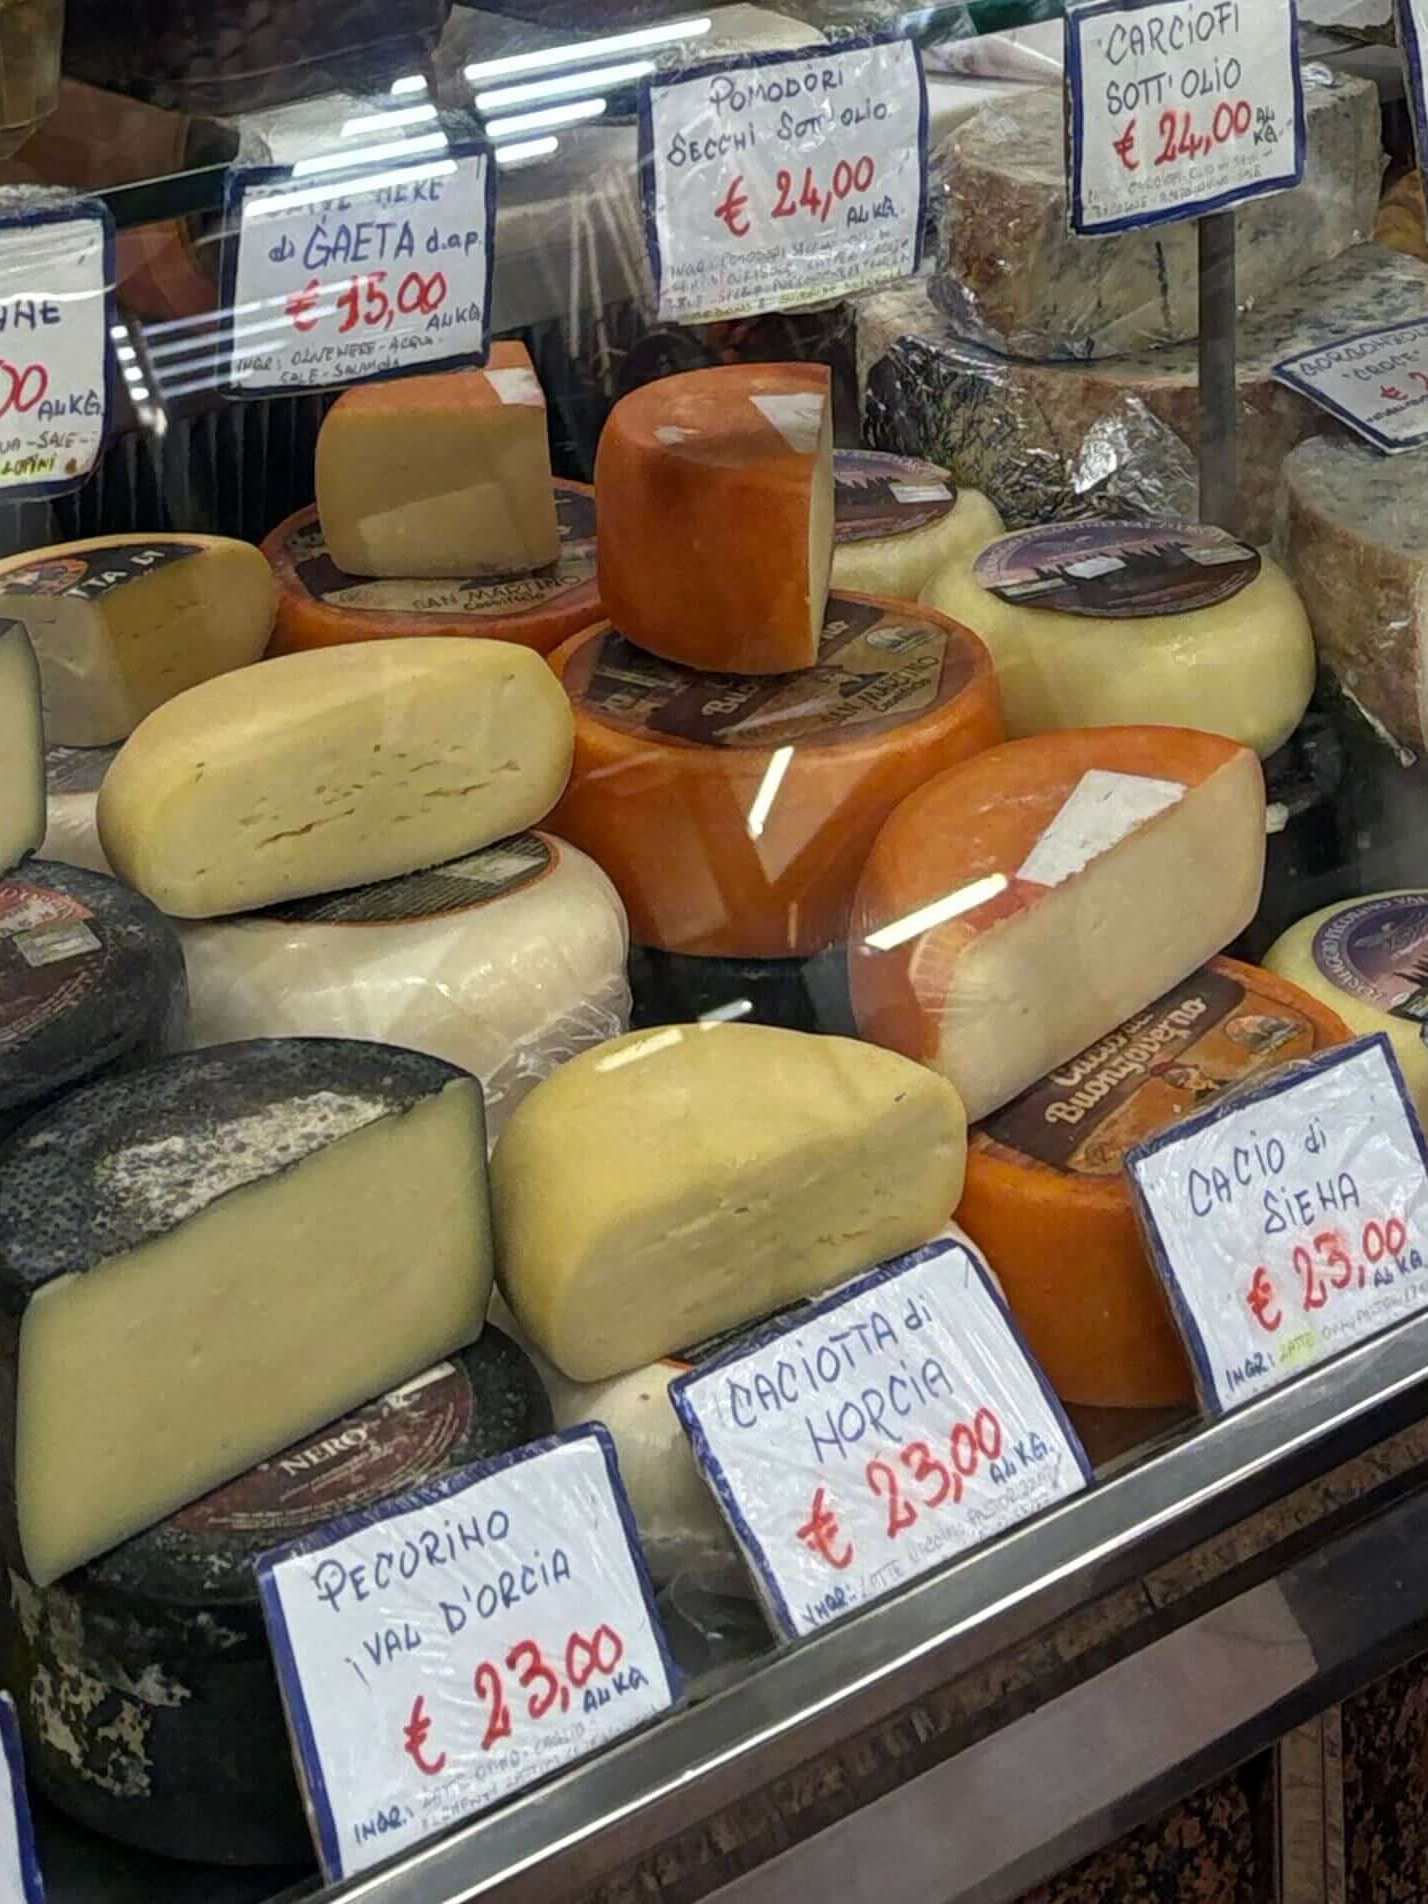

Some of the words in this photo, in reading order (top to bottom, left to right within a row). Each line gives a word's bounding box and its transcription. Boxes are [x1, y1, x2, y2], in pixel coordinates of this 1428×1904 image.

[709, 68, 845, 112] POMODORI
[1180, 57, 1242, 99] OLIO
[666, 123, 757, 168] SECCHI
[840, 101, 888, 126] OLIO
[1113, 120, 1140, 170] €
[1154, 101, 1252, 166] 24,00
[714, 175, 750, 238] €
[770, 155, 875, 223] 24,00
[302, 220, 415, 270] GAETA
[336, 271, 448, 334] 15,00
[1044, 995, 1207, 1125] Buongoverno
[1186, 1130, 1286, 1218] CACIO
[1303, 1115, 1327, 1155] di
[1263, 1172, 1361, 1235] SIENA
[1245, 1265, 1283, 1333] €
[1292, 1217, 1407, 1313] 23,00
[729, 1310, 900, 1430] CACIOTTA
[903, 1294, 934, 1331] di
[280, 1429, 368, 1477] NERO
[804, 1357, 955, 1464] NORCIA
[795, 1486, 854, 1570] €
[865, 1406, 1003, 1540] 23,00
[312, 1509, 511, 1612] PECORINO
[362, 1622, 423, 1668] VAL
[439, 1547, 573, 1636] D'ORCIA
[403, 1694, 446, 1776] €
[474, 1623, 623, 1751] 23,00
